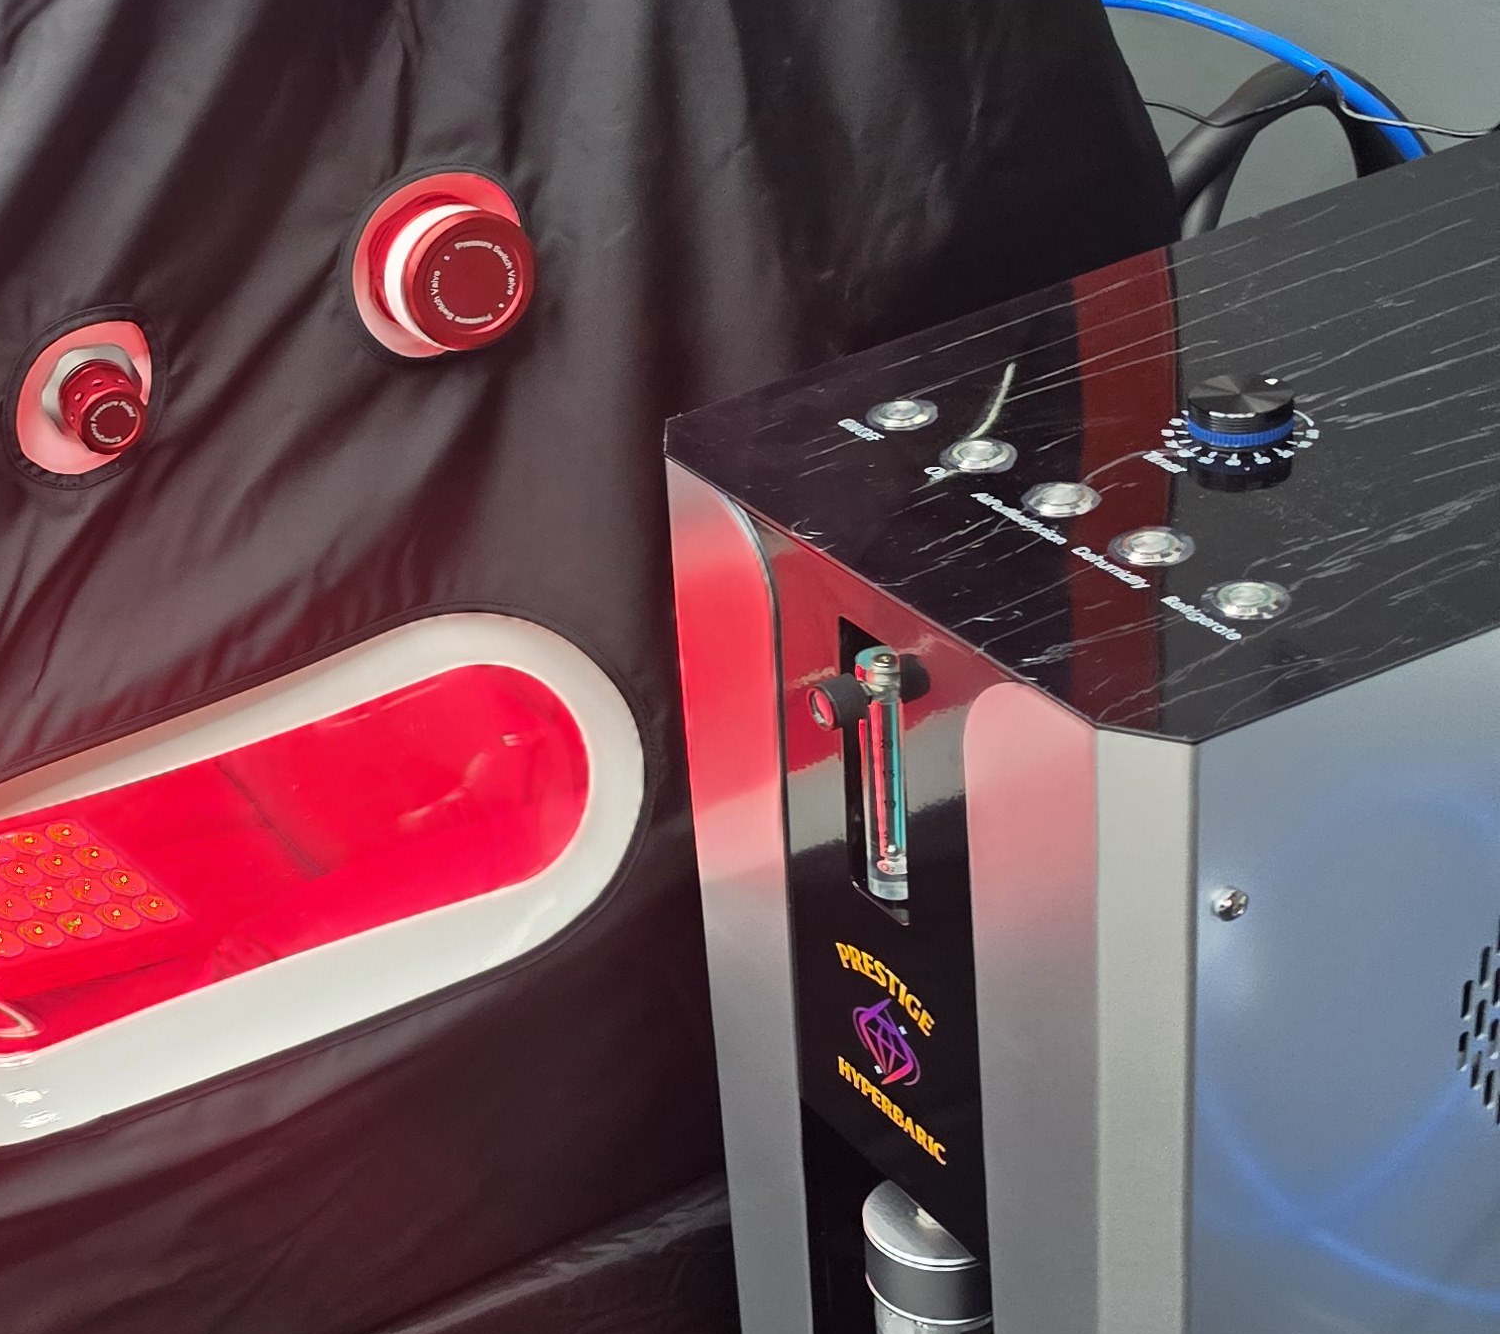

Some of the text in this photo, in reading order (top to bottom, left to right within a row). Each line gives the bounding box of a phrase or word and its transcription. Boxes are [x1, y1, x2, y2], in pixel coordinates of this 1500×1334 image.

[430, 270, 441, 296] Valve
[492, 245, 513, 269] Switch
[507, 269, 516, 296] Valve
[433, 296, 455, 321] Switch
[835, 942, 936, 1037] PRESTIGE
[837, 1055, 947, 1165] HYPERBARIC
